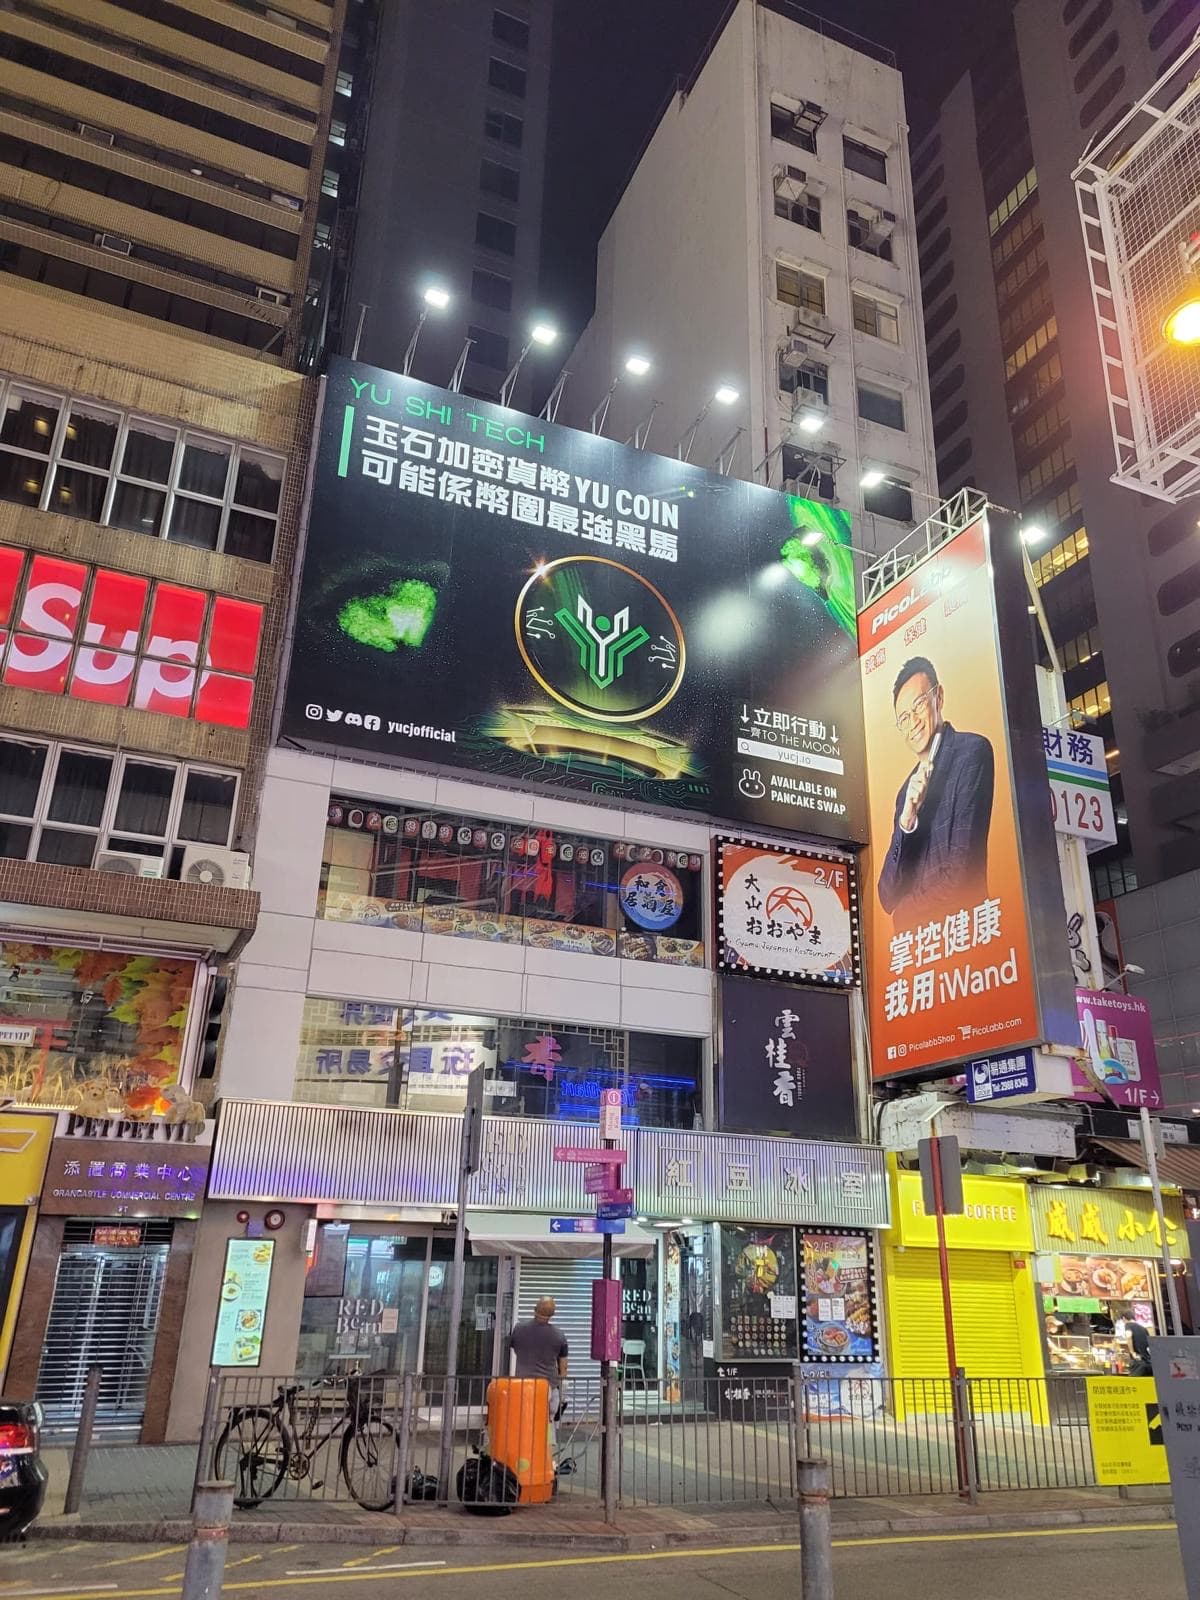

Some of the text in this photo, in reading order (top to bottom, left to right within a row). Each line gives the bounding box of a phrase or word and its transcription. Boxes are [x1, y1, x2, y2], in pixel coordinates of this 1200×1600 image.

[350, 377, 545, 453] YU SHI TECH
[363, 415, 679, 530] 玉石加密貨幣 YU COIN
[361, 449, 678, 563] 可能係幣圈最強黑馬
[388, 711, 456, 743] yucjofficial
[753, 707, 826, 740] 立即行動
[780, 733, 800, 748] THE
[802, 740, 841, 757] MOON
[770, 775, 838, 799] AVAILABLE ON
[771, 790, 847, 816] PANCAKE SWAP
[814, 867, 845, 889] 2/F
[744, 873, 762, 911] 大山
[746, 917, 822, 946] おおやま
[889, 898, 1002, 976] 掌控健康
[1124, 1087, 1147, 1103] 1/F
[111, 1190, 160, 1201] COMMERCIAL
[165, 1192, 196, 1202] CENTRE
[965, 1204, 1017, 1222] COFFEE
[339, 1299, 384, 1316] RED
[622, 1289, 652, 1302] RED
